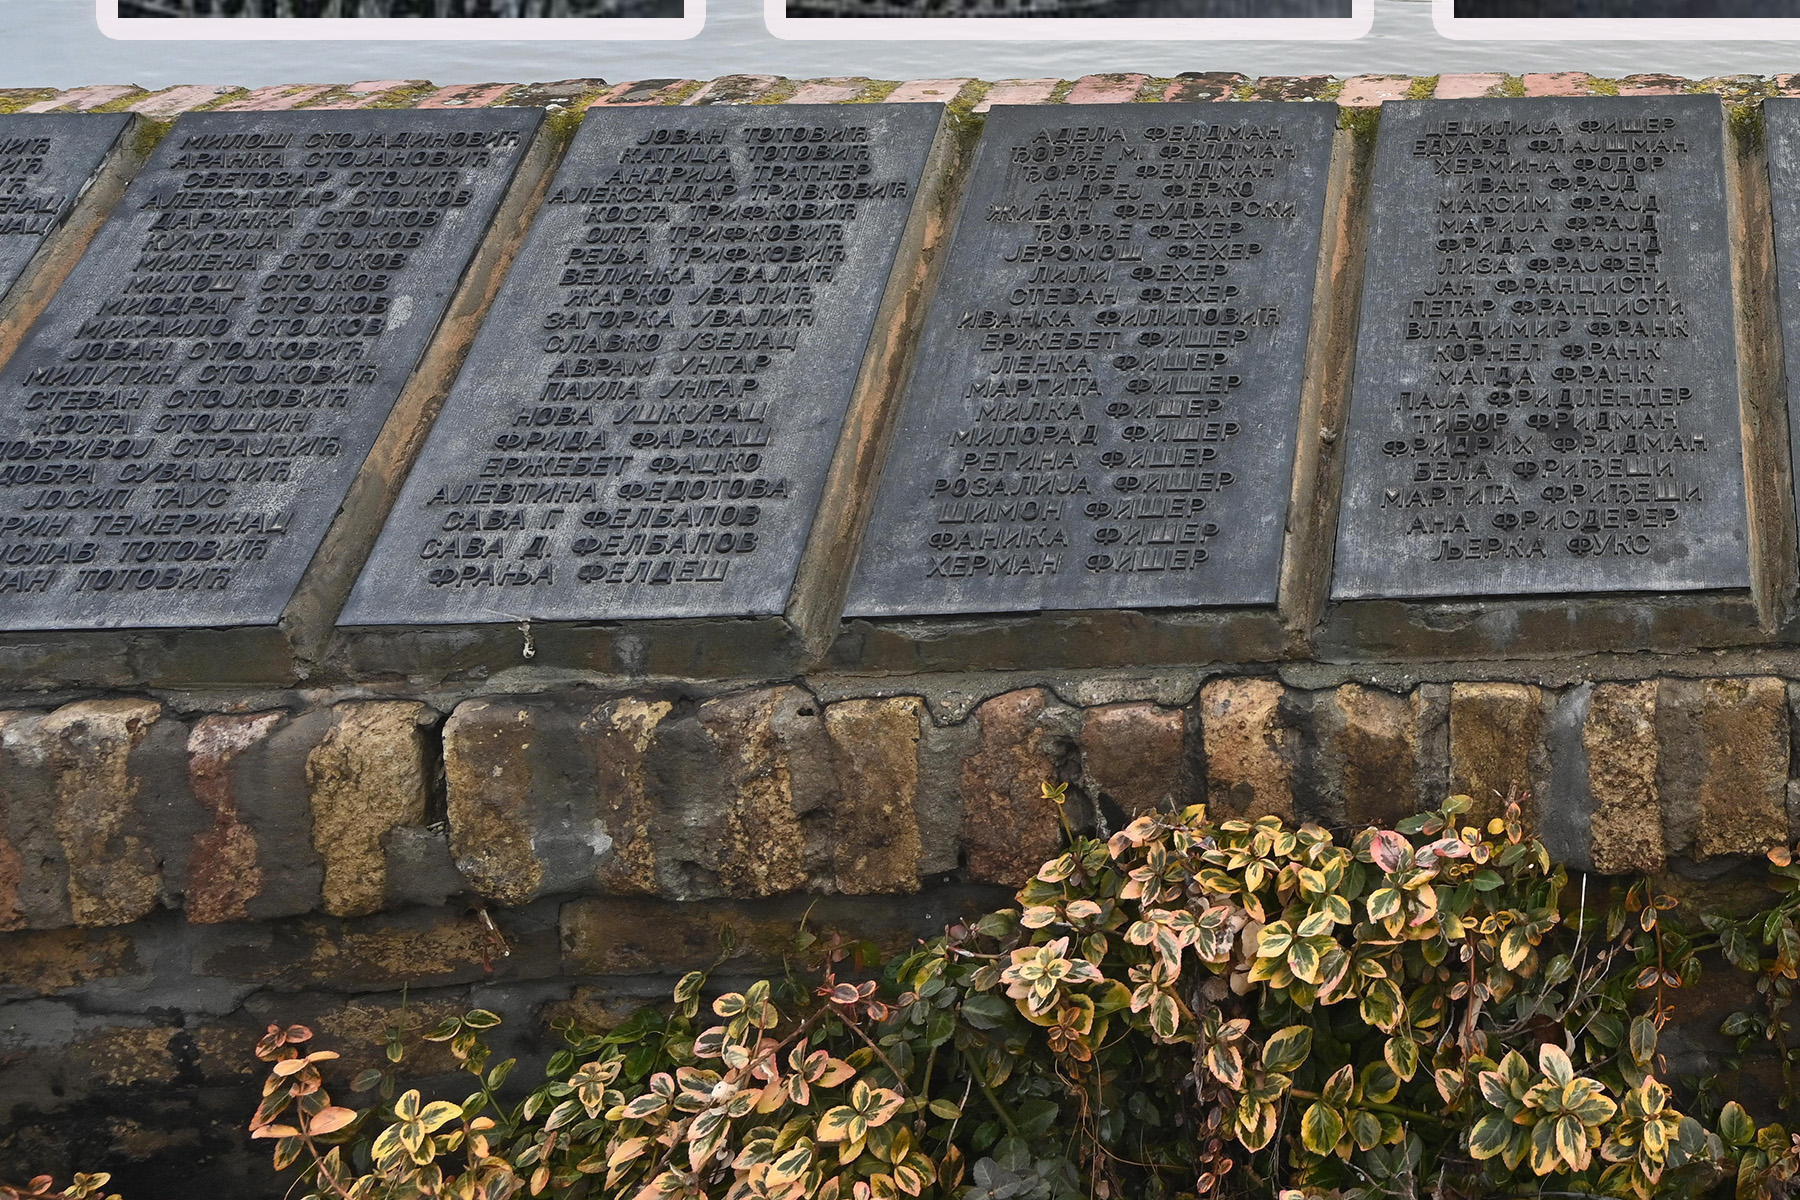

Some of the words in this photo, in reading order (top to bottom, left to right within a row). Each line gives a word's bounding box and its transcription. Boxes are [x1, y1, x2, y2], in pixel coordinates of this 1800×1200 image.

[636, 129, 727, 145] ЈОВАН
[743, 126, 869, 143] ТОТОВИЋ
[1032, 127, 1127, 143] АДЕЛА
[1142, 124, 1283, 141] ФЕЛДМАН
[1425, 121, 1562, 137] ЦЕЦИЛИЈА
[1578, 119, 1676, 135] ФИШЕР
[180, 133, 292, 149] МИЛОШ
[304, 130, 521, 149] СТОЈАДИНОВИЋ
[606, 166, 737, 184] АНДРИЈА
[754, 164, 874, 180] ТРАТНЕР
[1023, 164, 1119, 182] ЂОРЂЕ
[1135, 162, 1276, 179] ФЕЛДМАН
[1435, 157, 1561, 174] ХЕРМИНА
[1572, 156, 1666, 173] ФОДОР
[183, 171, 329, 189] СВЕТОЗАР
[346, 171, 457, 187] СТОЈИЋ
[141, 191, 337, 209] АЛЕКСАНДАР
[353, 190, 475, 207] СТОЈКОВ
[1034, 183, 1142, 200] АНДРЕЈ
[1160, 182, 1256, 198] ФЕРКО
[1433, 197, 1551, 214] МАКСИМ
[1570, 196, 1660, 213] ФРАЈД
[141, 232, 280, 251] КУМРИЈА
[297, 232, 425, 250] СТОЈКОВ
[585, 227, 652, 243] ОЛГА
[669, 224, 844, 242] ТРИФКОВИЋ
[1438, 257, 1511, 275] ЛИЗА
[1527, 256, 1659, 273] ФРАЈФЕН
[122, 274, 245, 293] МИЛОШ
[259, 274, 389, 292] СТОЈКОВ
[1008, 287, 1120, 306] СТЕВАН
[1139, 285, 1242, 304] ФЕХЕР
[956, 309, 1077, 330] ИВАНКА
[1094, 306, 1281, 327] ФИЛИПОВИЋ
[1410, 300, 1497, 318] ПЕТАР
[1510, 298, 1684, 317] ФРАНЦИСТИ
[542, 311, 677, 331] ЗАГОРКА
[692, 309, 815, 328] УВАЛИЋ
[990, 354, 1094, 374] ЛЕНКА
[1113, 352, 1231, 372] ФИШЕР
[22, 365, 181, 386] МИЛУТИН
[198, 364, 378, 384] СТОЈКОВИЋ
[23, 391, 148, 411] СТЕВАН
[165, 389, 348, 408] СТОЈКОВИЋ
[540, 380, 640, 401] ПАУЛА
[659, 379, 759, 398] УНГАР
[512, 406, 595, 426] НОВА
[613, 403, 767, 424] УШКУРАЦ
[975, 401, 1085, 422] МИЛКА
[1104, 399, 1225, 419] ФИШЕР
[33, 415, 131, 435] КОСТА
[153, 414, 312, 434] СТОЈШИН
[1414, 414, 1510, 433] ТИБОР
[1526, 412, 1679, 430] ФРИДМАН
[479, 457, 634, 478] ЕРЖЕБЕТ
[647, 453, 761, 476] ФАЦКО
[1413, 461, 1494, 481] БЕЛА
[1512, 459, 1674, 479] ФРИЂЕШИ
[929, 476, 1093, 498] РОЗАЛИЈА
[1113, 472, 1238, 493] ФИШЕР
[23, 489, 136, 510] ЈОСИП
[152, 488, 232, 508] ТАУС
[89, 513, 296, 535] ТЕМЕРИНАЦ
[441, 510, 526, 532] САВА
[580, 505, 761, 529] ФЕЛБАПОВ
[1407, 514, 1470, 535] АНА
[1491, 509, 1680, 531] ФРИСДЕРЕР
[1431, 539, 1547, 562] ЉЕРКА
[1565, 535, 1651, 556] ФУКС
[425, 564, 554, 587] ФРАЊА
[576, 560, 730, 585] ФЕЛДЕШ
[926, 553, 1065, 579] ХЕРМАН
[1084, 549, 1210, 574] ФИШЕР
[76, 568, 232, 593] ТОТОВИЋ
